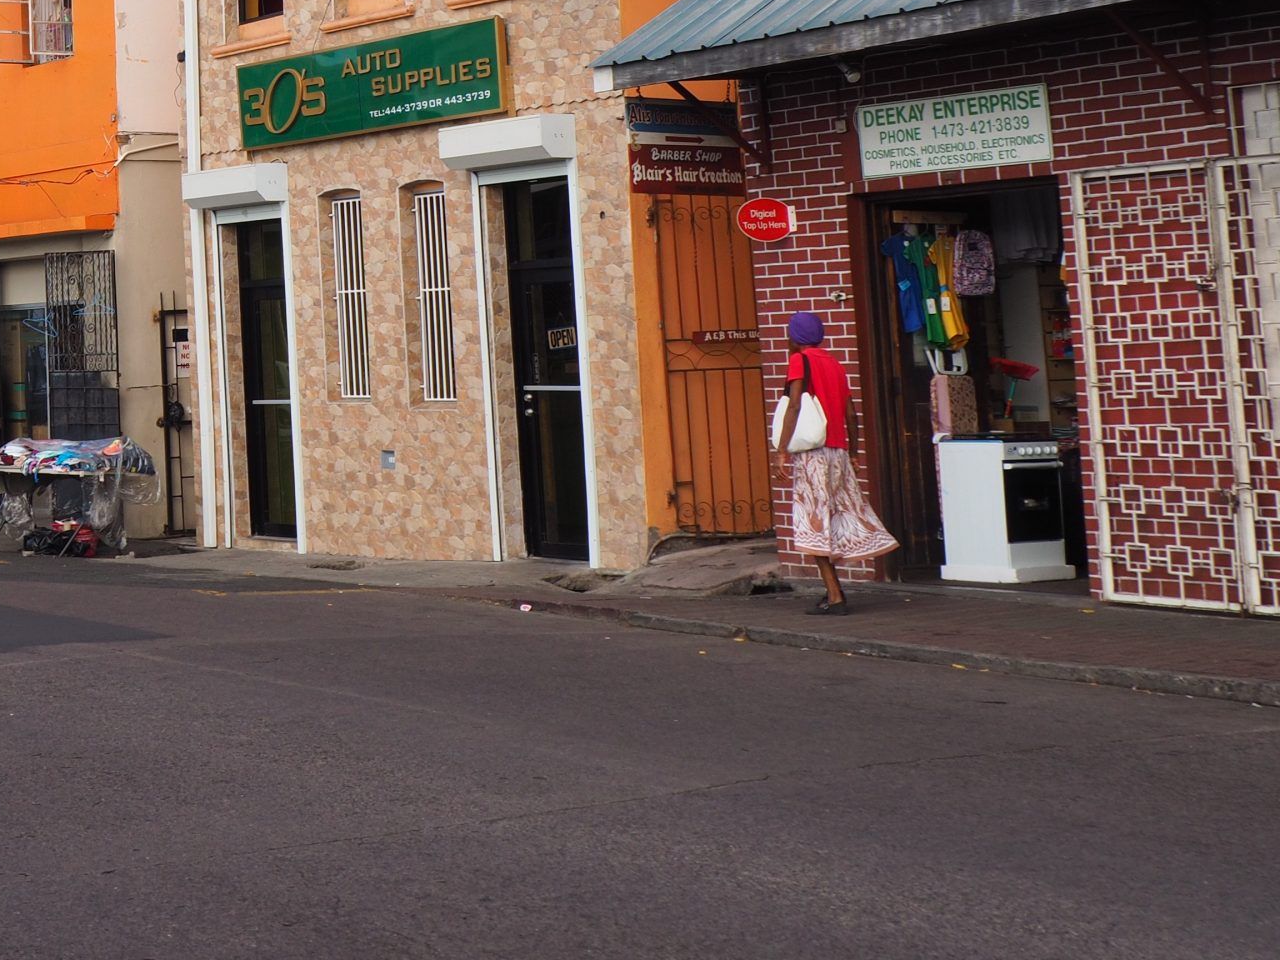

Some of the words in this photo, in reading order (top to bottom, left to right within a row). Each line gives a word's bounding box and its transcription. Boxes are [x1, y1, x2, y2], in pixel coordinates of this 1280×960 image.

[340, 48, 401, 78] AUTO
[371, 57, 492, 98] SUPPLIES
[444, 90, 491, 105] 443-3739
[862, 103, 926, 128] DEEKAY
[932, 89, 1042, 120] ENTERPRISE
[879, 126, 922, 145] PHONE
[931, 115, 1030, 140] 1-473-421-3839
[981, 133, 1046, 150] ELECTRONICS
[651, 147, 691, 161] BARBER
[694, 149, 722, 162] SHOP
[889, 155, 922, 170] PHONE
[927, 150, 993, 168] ACCESSORIES
[631, 157, 673, 185] Blair's
[674, 166, 699, 182] Hair
[699, 166, 743, 184] Creation
[750, 209, 777, 220] Digicel
[742, 221, 757, 231] Top
[757, 221, 768, 230] Up
[768, 221, 787, 229] Here
[550, 328, 575, 348] OPEN
[727, 330, 747, 339] This
